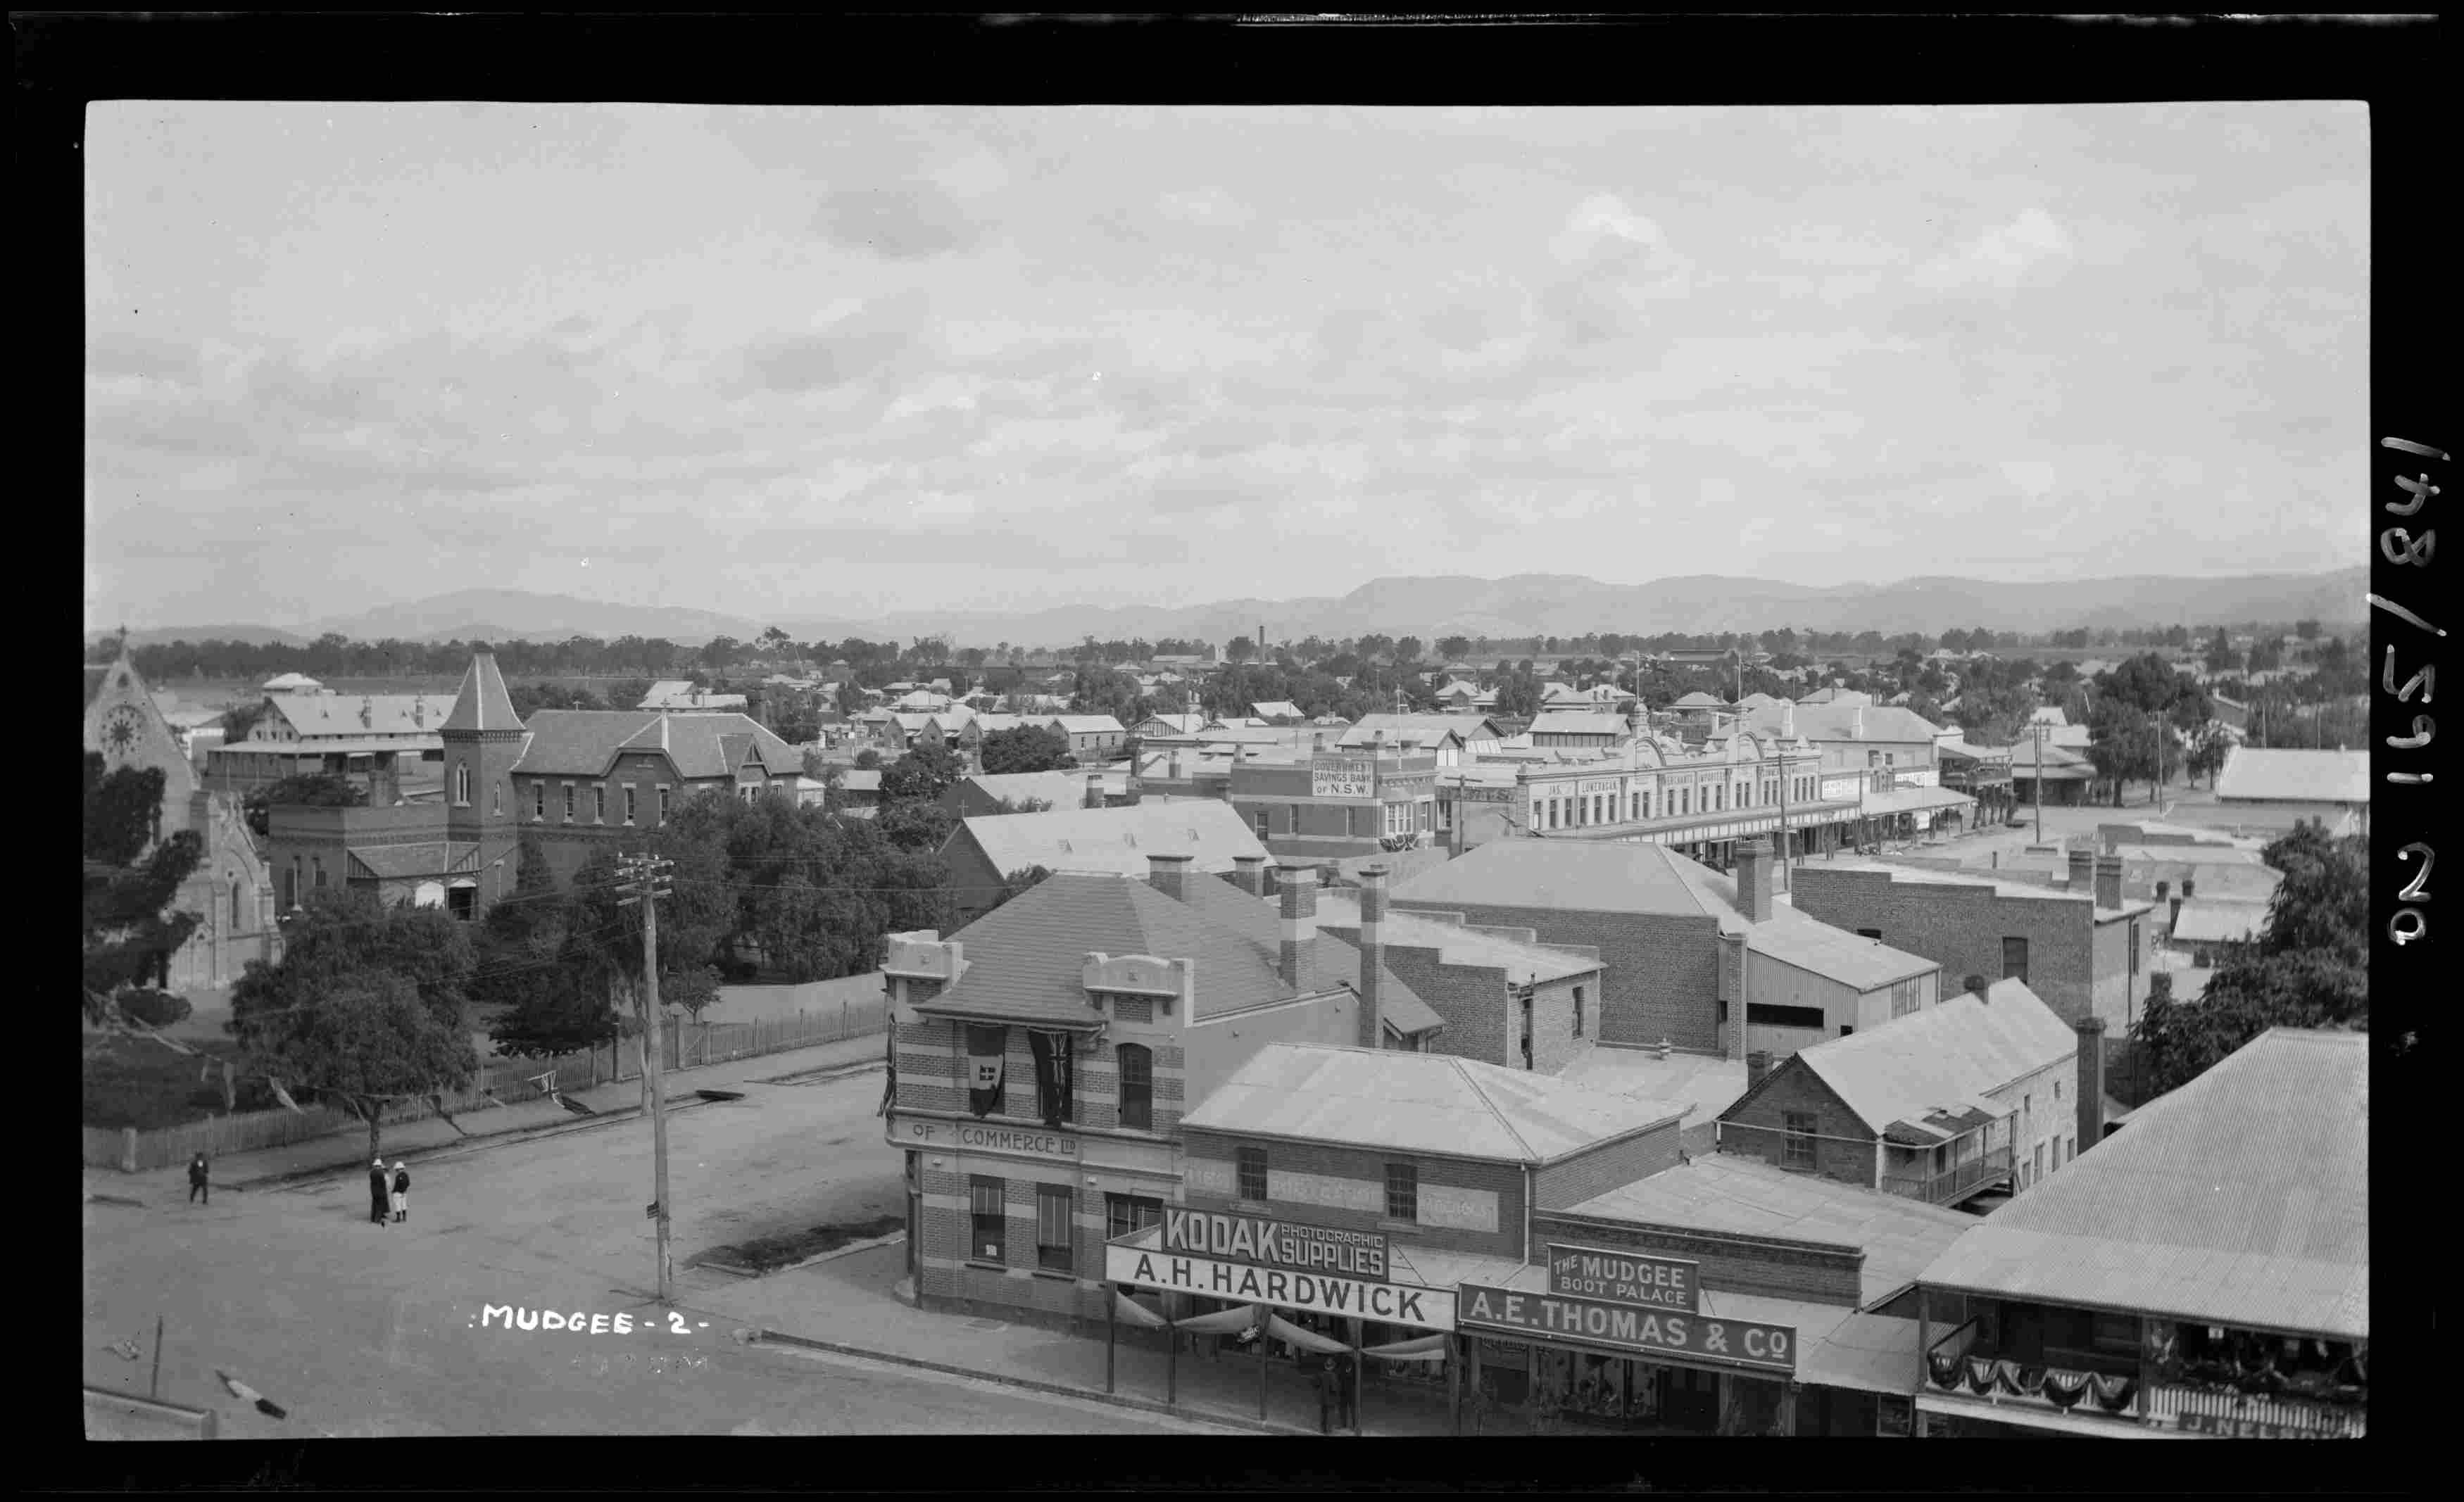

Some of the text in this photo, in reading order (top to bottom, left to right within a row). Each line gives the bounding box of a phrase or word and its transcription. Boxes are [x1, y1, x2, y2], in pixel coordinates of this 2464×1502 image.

[1314, 772, 1371, 783] SAVINGS BANK
[1331, 783, 1369, 794] N.S.W.
[912, 1123, 936, 1141] OF
[962, 1128, 1055, 1154] COMMERCE
[1166, 1208, 1383, 1263] KODAK PHOTOGRAPHIC
[1282, 1242, 1383, 1276] SUPPLIES
[1554, 1254, 1686, 1289] THE MUDGEE
[1560, 1276, 1687, 1306] BOOT PALACE
[1705, 1323, 1729, 1353] &
